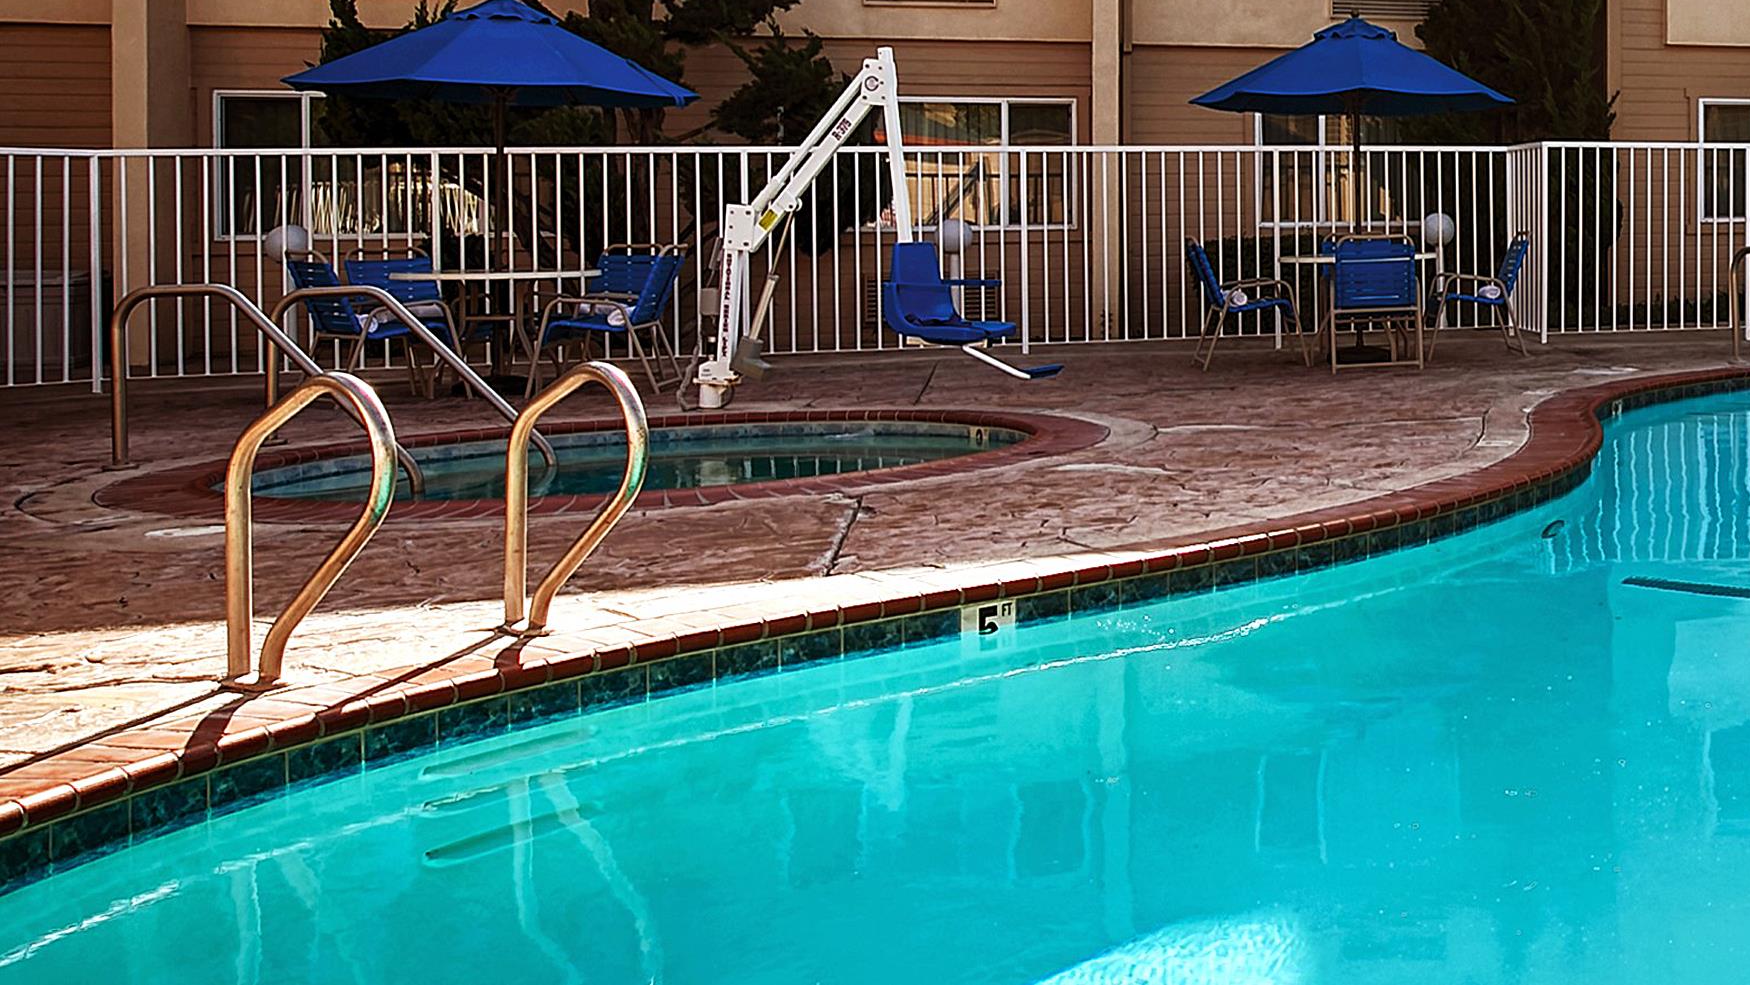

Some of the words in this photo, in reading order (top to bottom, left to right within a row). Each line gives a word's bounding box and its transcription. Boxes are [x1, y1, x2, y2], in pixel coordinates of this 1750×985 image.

[831, 117, 852, 141] R-375
[978, 605, 999, 635] 5
[1001, 602, 1013, 617] FT
